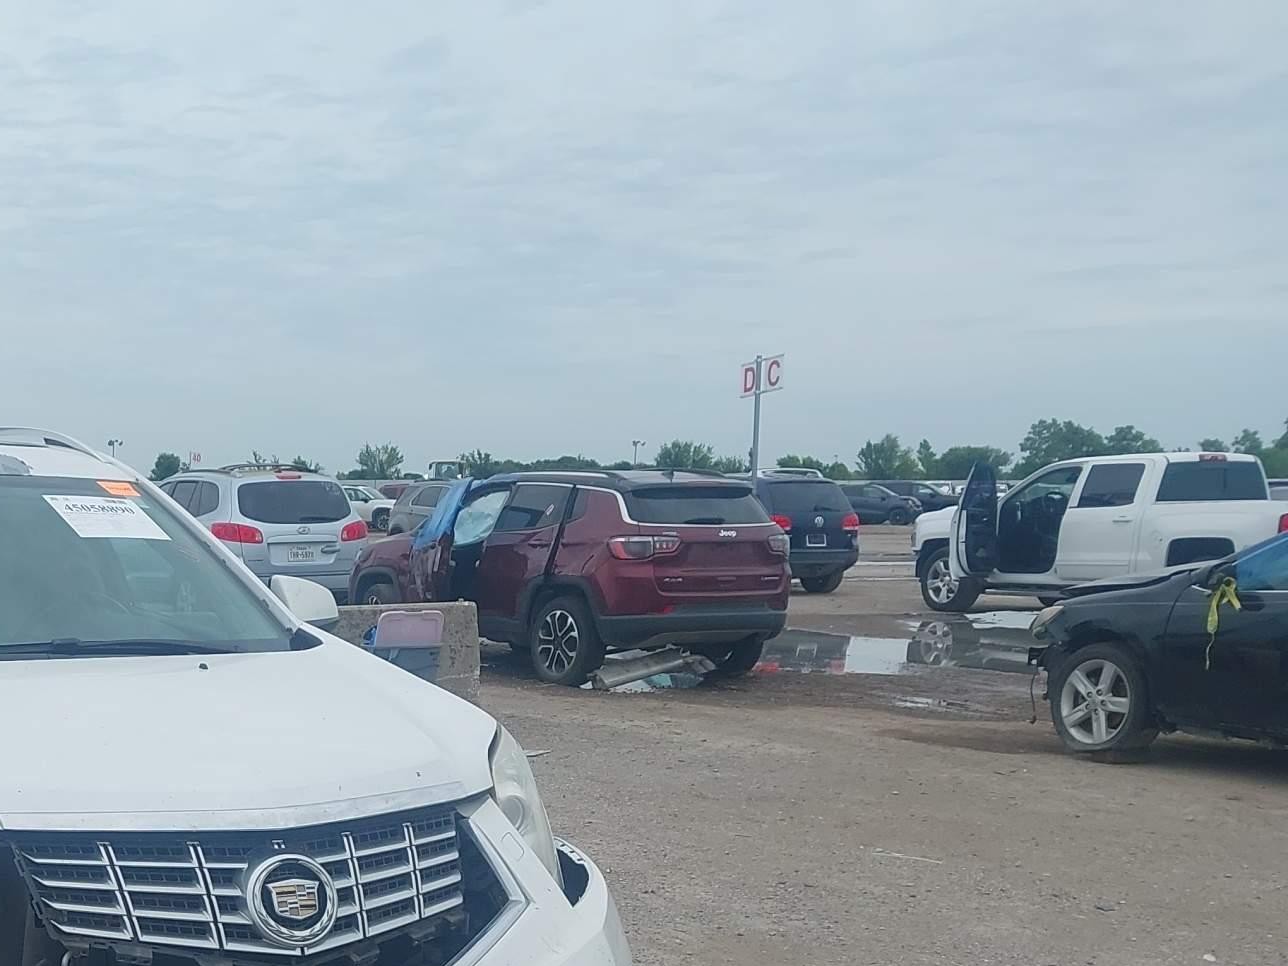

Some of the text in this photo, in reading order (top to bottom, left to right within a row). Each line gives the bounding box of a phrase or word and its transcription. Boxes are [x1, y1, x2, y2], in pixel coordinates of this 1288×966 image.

[744, 367, 755, 393] D
[768, 361, 780, 387] C
[63, 502, 136, 515] 45058890
[718, 529, 737, 537] Jeep
